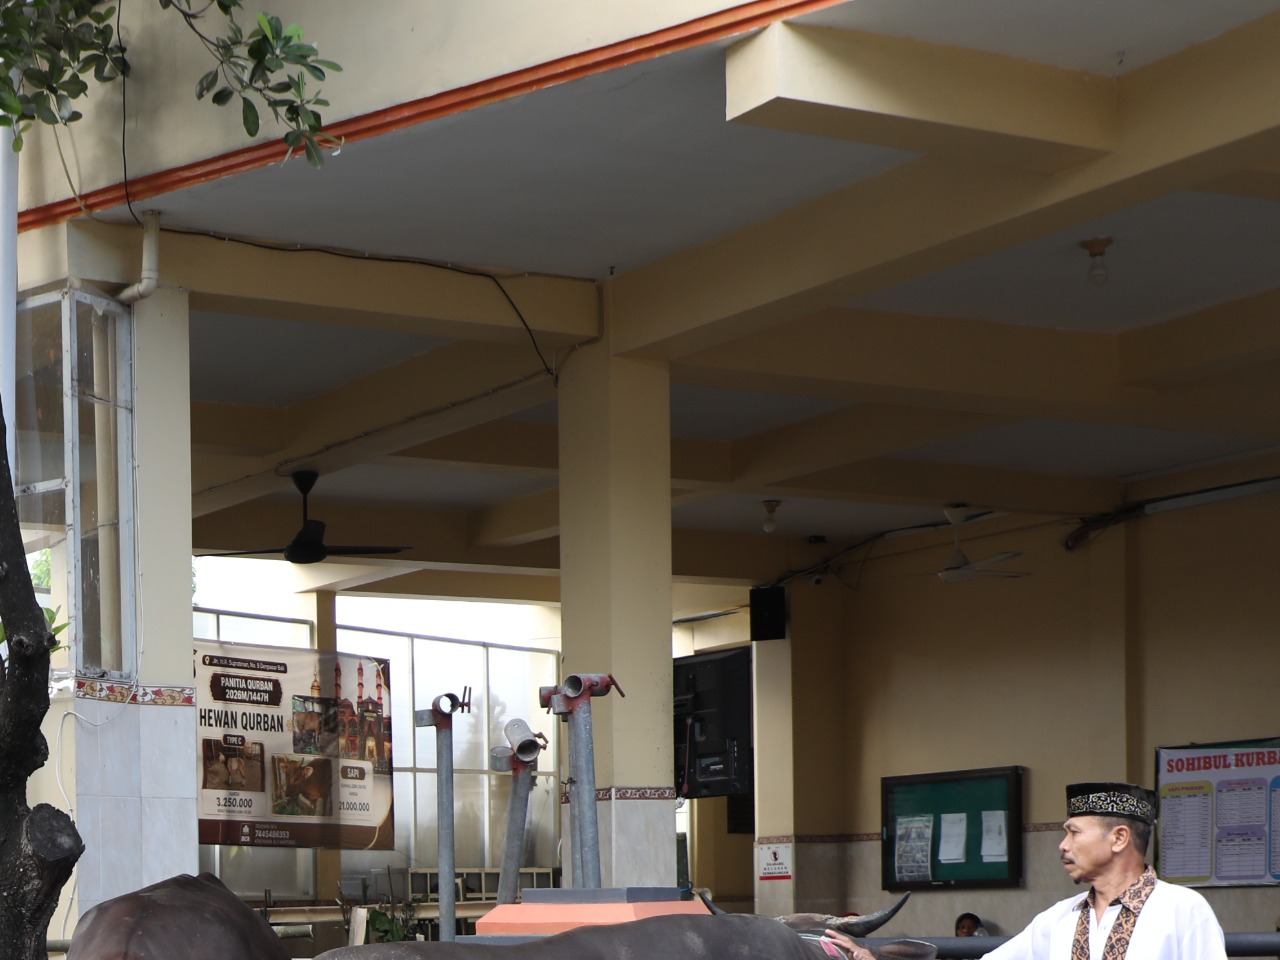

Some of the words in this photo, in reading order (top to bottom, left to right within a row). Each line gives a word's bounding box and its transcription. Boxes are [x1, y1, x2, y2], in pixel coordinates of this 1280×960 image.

[220, 677, 246, 688] PANITIA
[247, 680, 273, 691] QURBAN
[226, 690, 269, 702] 2026M/1447H
[200, 708, 238, 729] HEWAN
[241, 712, 284, 733] QURBAN
[226, 736, 237, 744] TYPE
[1166, 754, 1231, 773] SOHIBUL
[1234, 750, 1280, 768] KURB
[347, 768, 359, 778] SAPI
[216, 797, 252, 808] 3.250.000
[338, 801, 370, 812] 21.000.000
